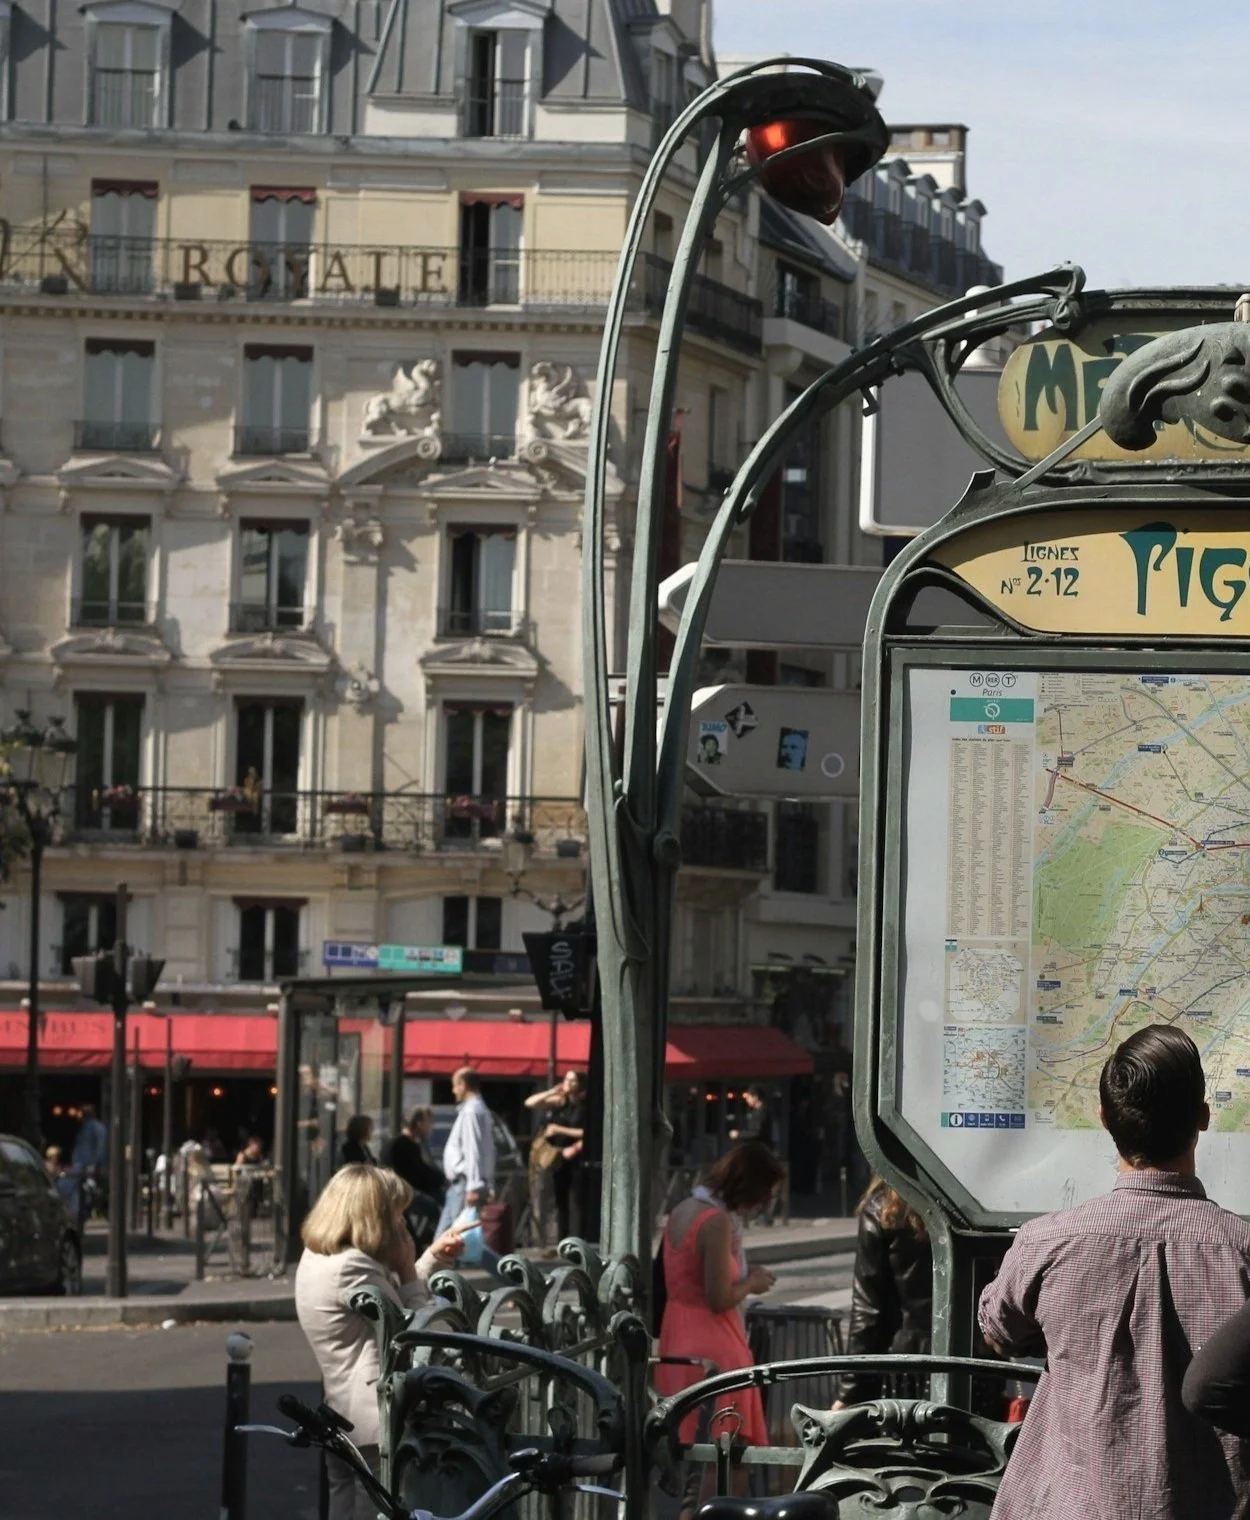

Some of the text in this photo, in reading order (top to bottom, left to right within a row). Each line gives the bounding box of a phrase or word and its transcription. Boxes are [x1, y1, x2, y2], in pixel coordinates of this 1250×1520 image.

[178, 244, 448, 298] ROYALE
[1021, 541, 1080, 563] LIGNES
[982, 688, 1003, 697] Paris
